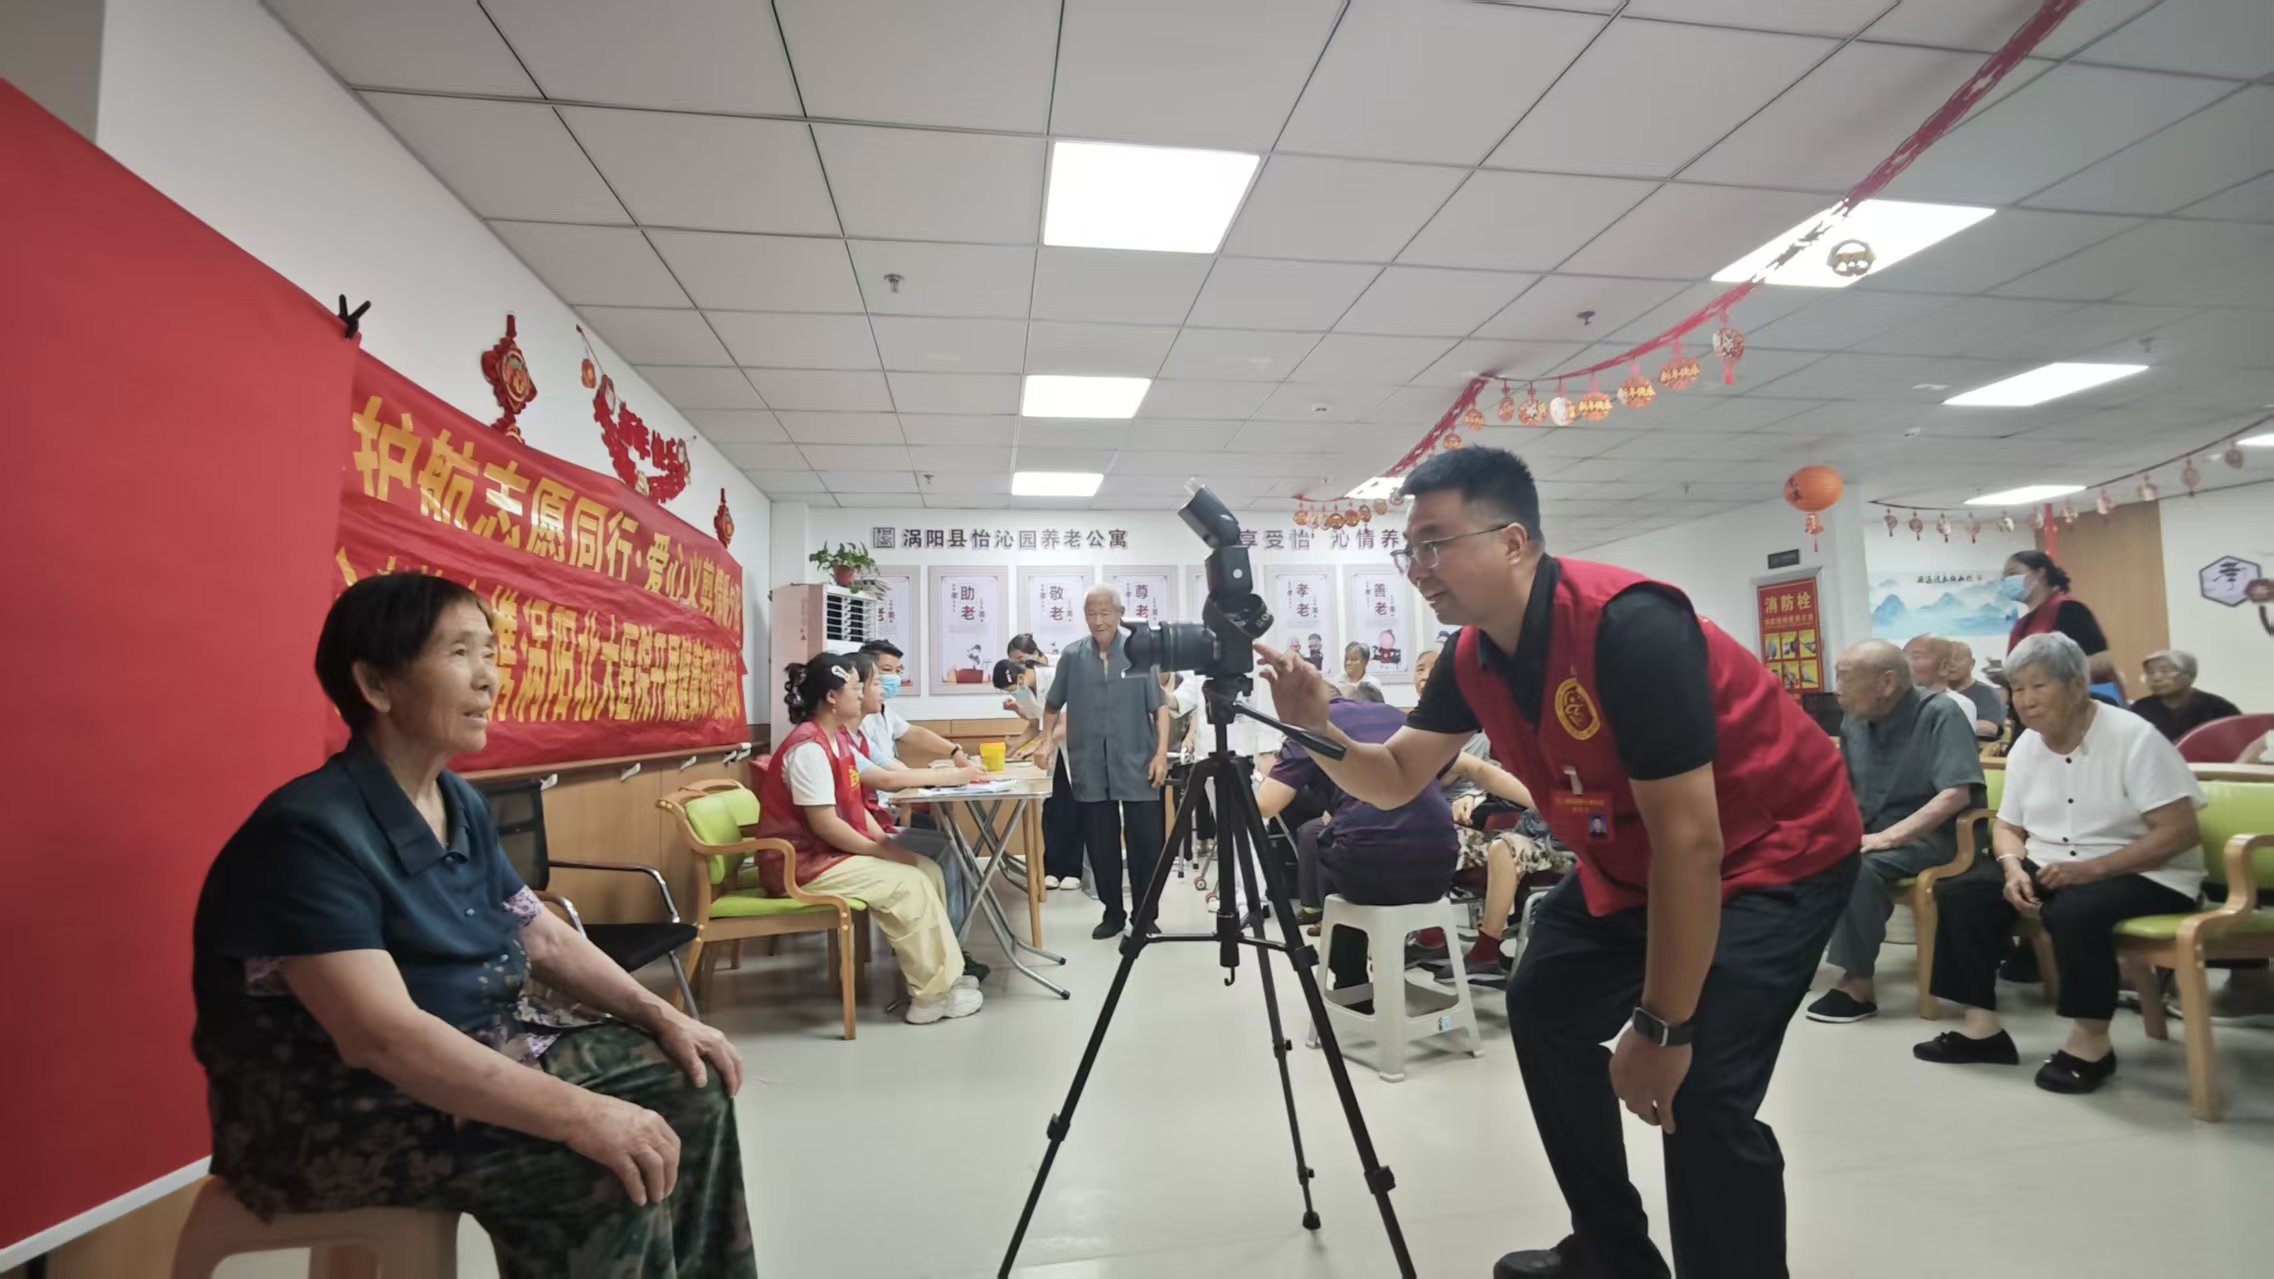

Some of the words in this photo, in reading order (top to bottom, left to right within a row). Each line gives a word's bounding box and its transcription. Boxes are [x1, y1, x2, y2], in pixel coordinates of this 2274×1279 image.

[902, 528, 1128, 549] 涡阳县怡沁园养老公寓
[960, 585, 976, 621] 助老
[1049, 585, 1064, 621] 敬老
[1135, 584, 1149, 619] 尊老
[1296, 583, 1311, 618] 孝老
[1374, 583, 1388, 616] 善老
[1764, 591, 1812, 614] 消防栓
